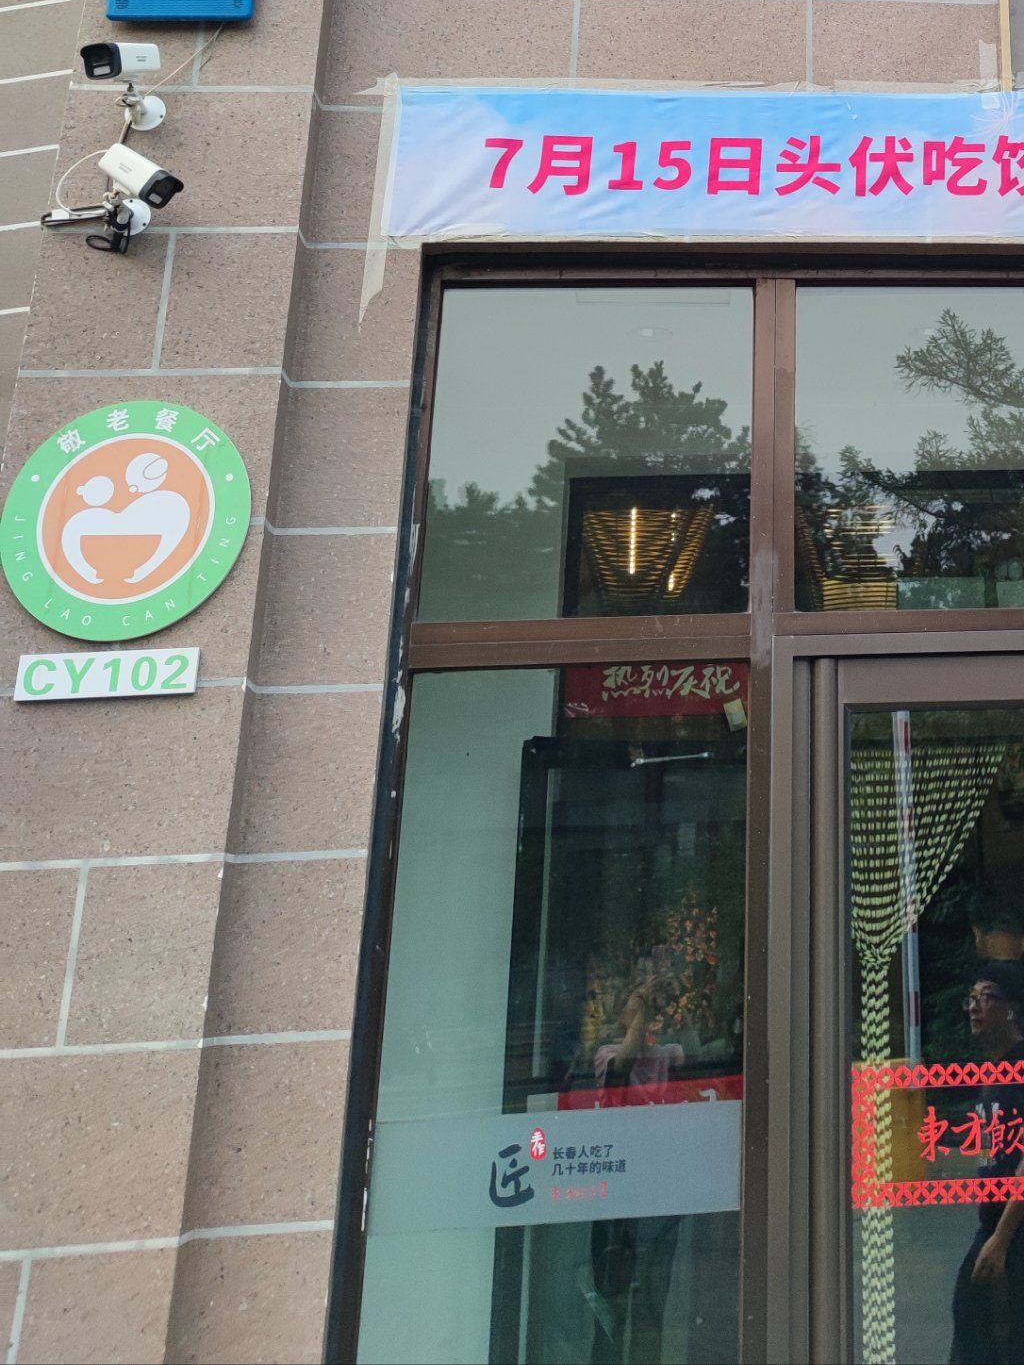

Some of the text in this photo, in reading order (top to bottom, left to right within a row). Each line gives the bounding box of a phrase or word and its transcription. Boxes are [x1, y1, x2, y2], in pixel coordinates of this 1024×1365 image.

[56, 407, 222, 454] 敬老餐厅
[13, 514, 237, 627] JING LAO CAN TING
[22, 654, 190, 696] CY102
[551, 1159, 627, 1177] 几十年的味道
[552, 1144, 614, 1160] 长春人吃了
[488, 1143, 535, 1208] 匠
